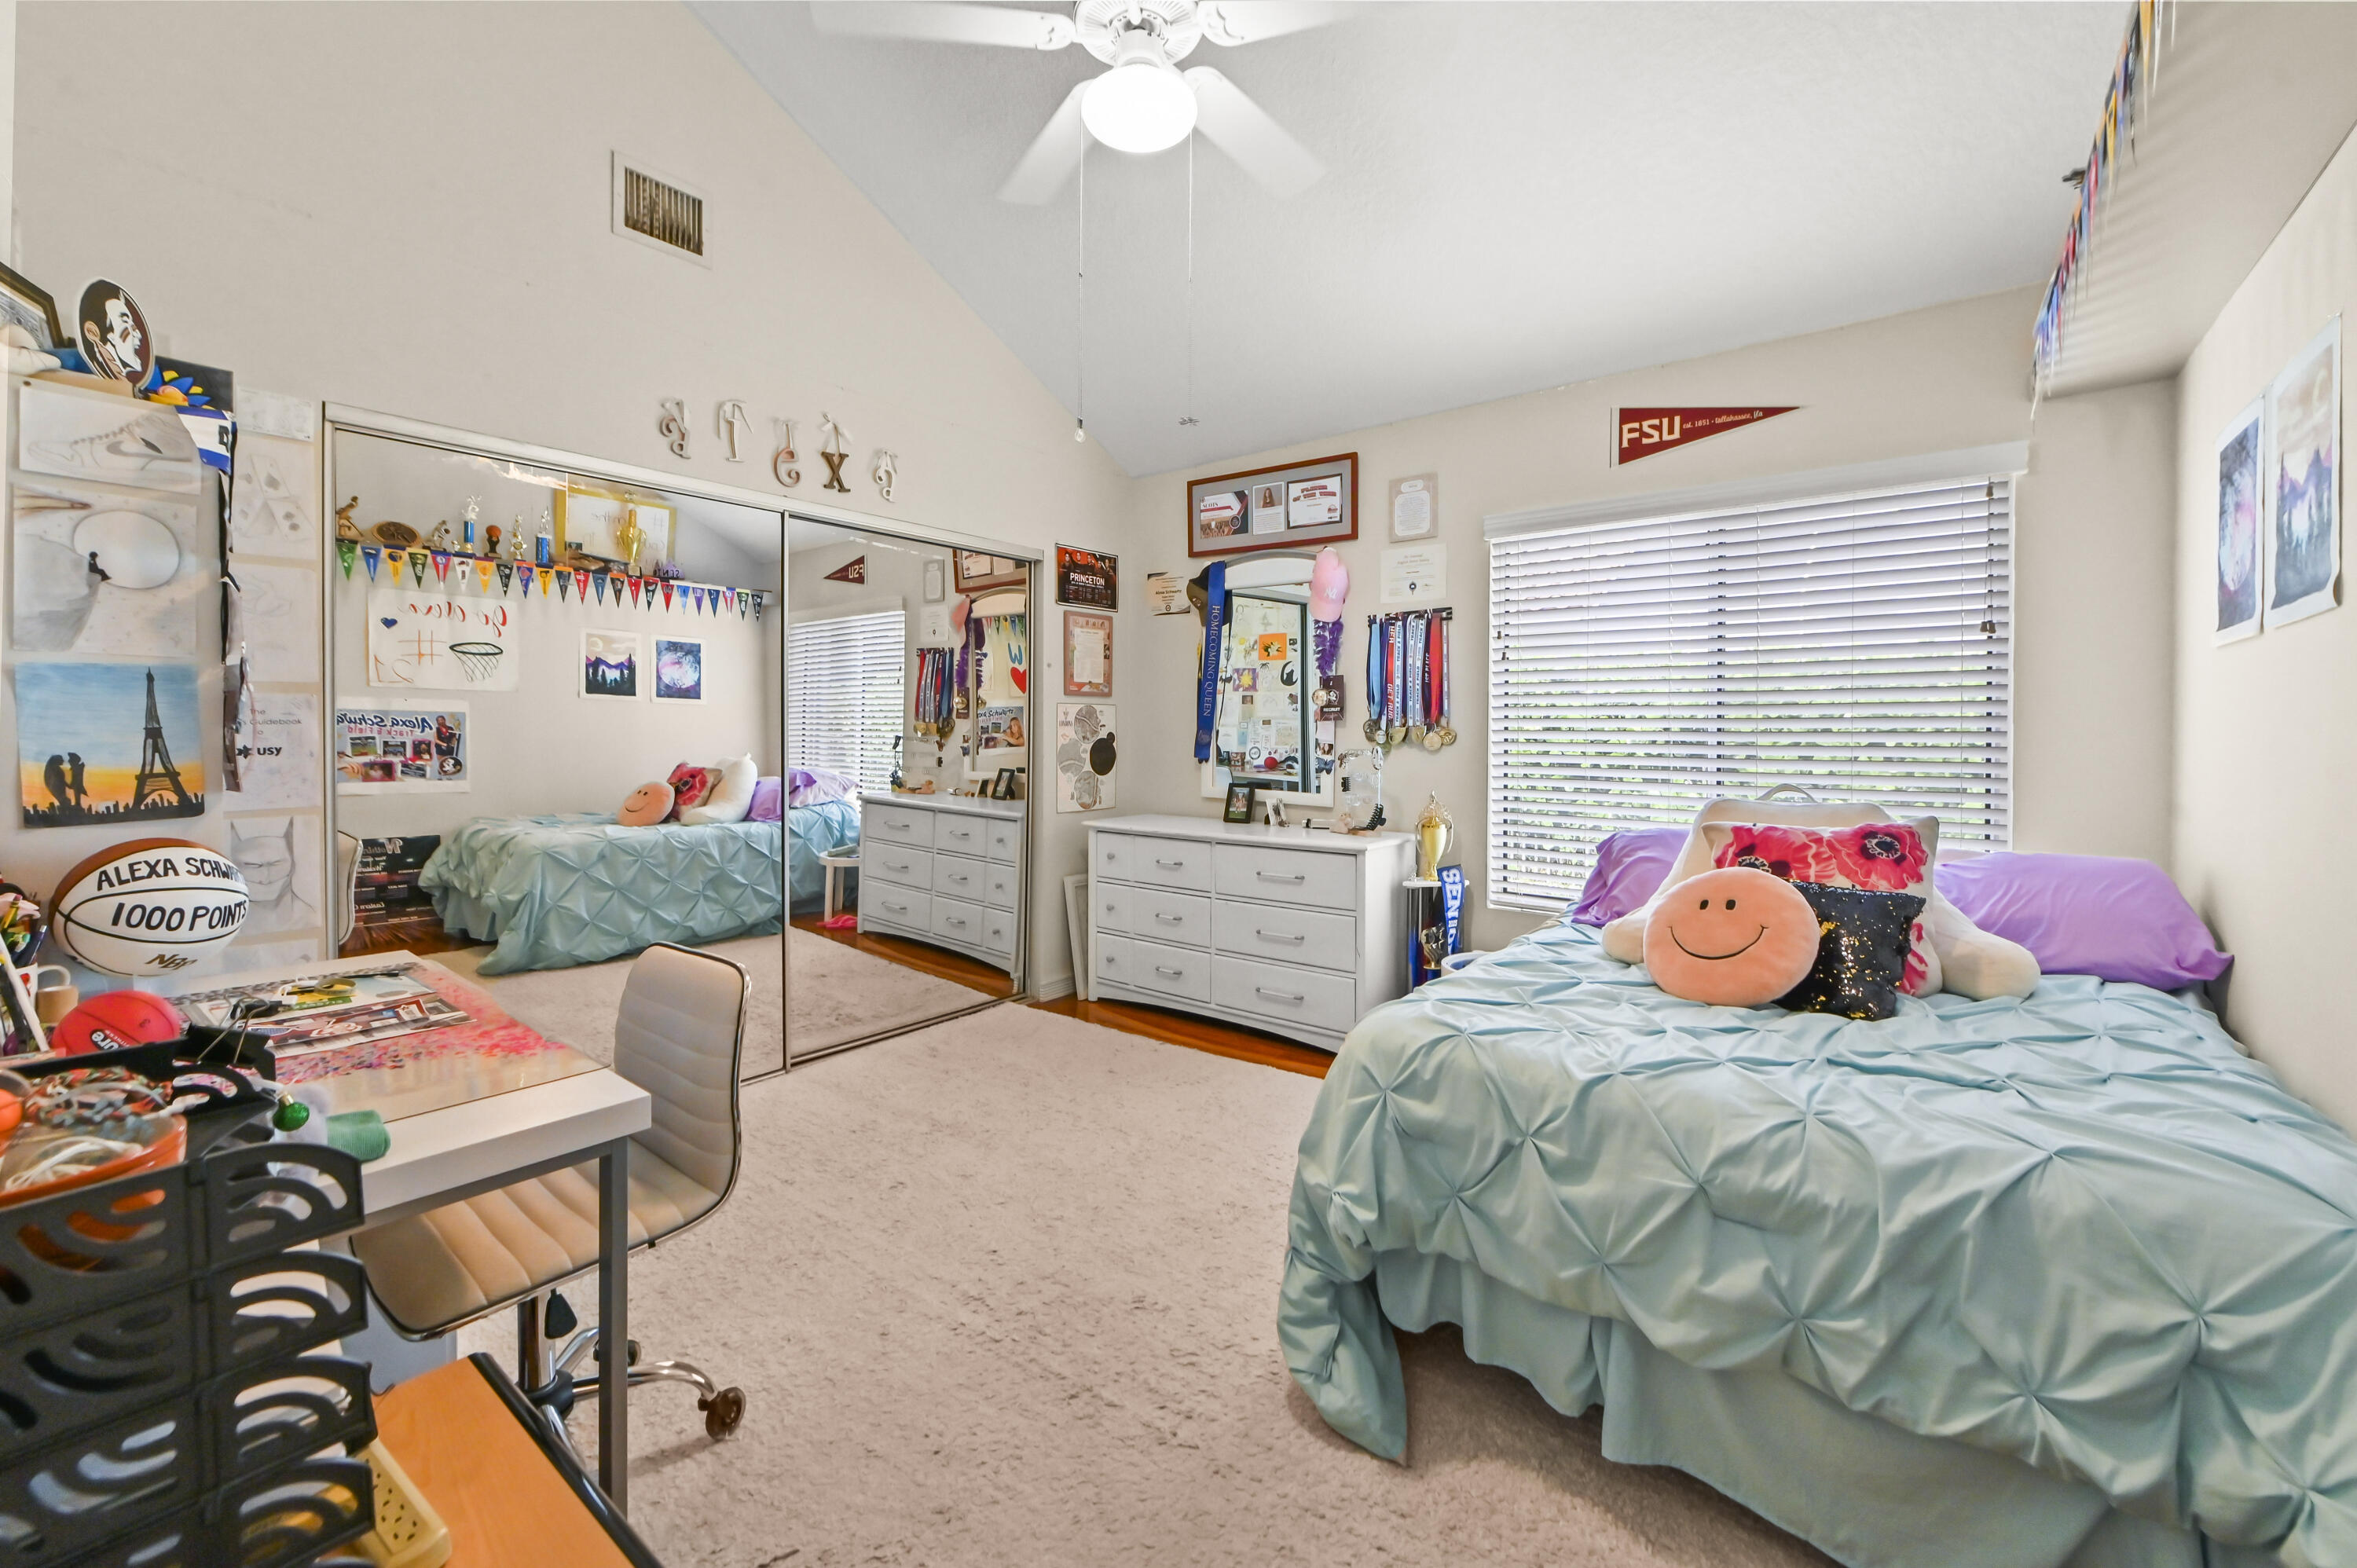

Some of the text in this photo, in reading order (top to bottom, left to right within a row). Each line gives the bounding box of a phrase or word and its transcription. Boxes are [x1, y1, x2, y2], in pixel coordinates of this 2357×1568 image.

[1621, 416, 1681, 449] FSU
[1695, 419, 1710, 427] 1851
[1070, 572, 1105, 586] PRINCETON
[1203, 606, 1221, 716] HOMECOMING QUEEN
[257, 746, 282, 757] usy
[97, 858, 180, 892] ALEXA
[112, 899, 247, 932] 1000 POINTS
[91, 1031, 120, 1050] ure
